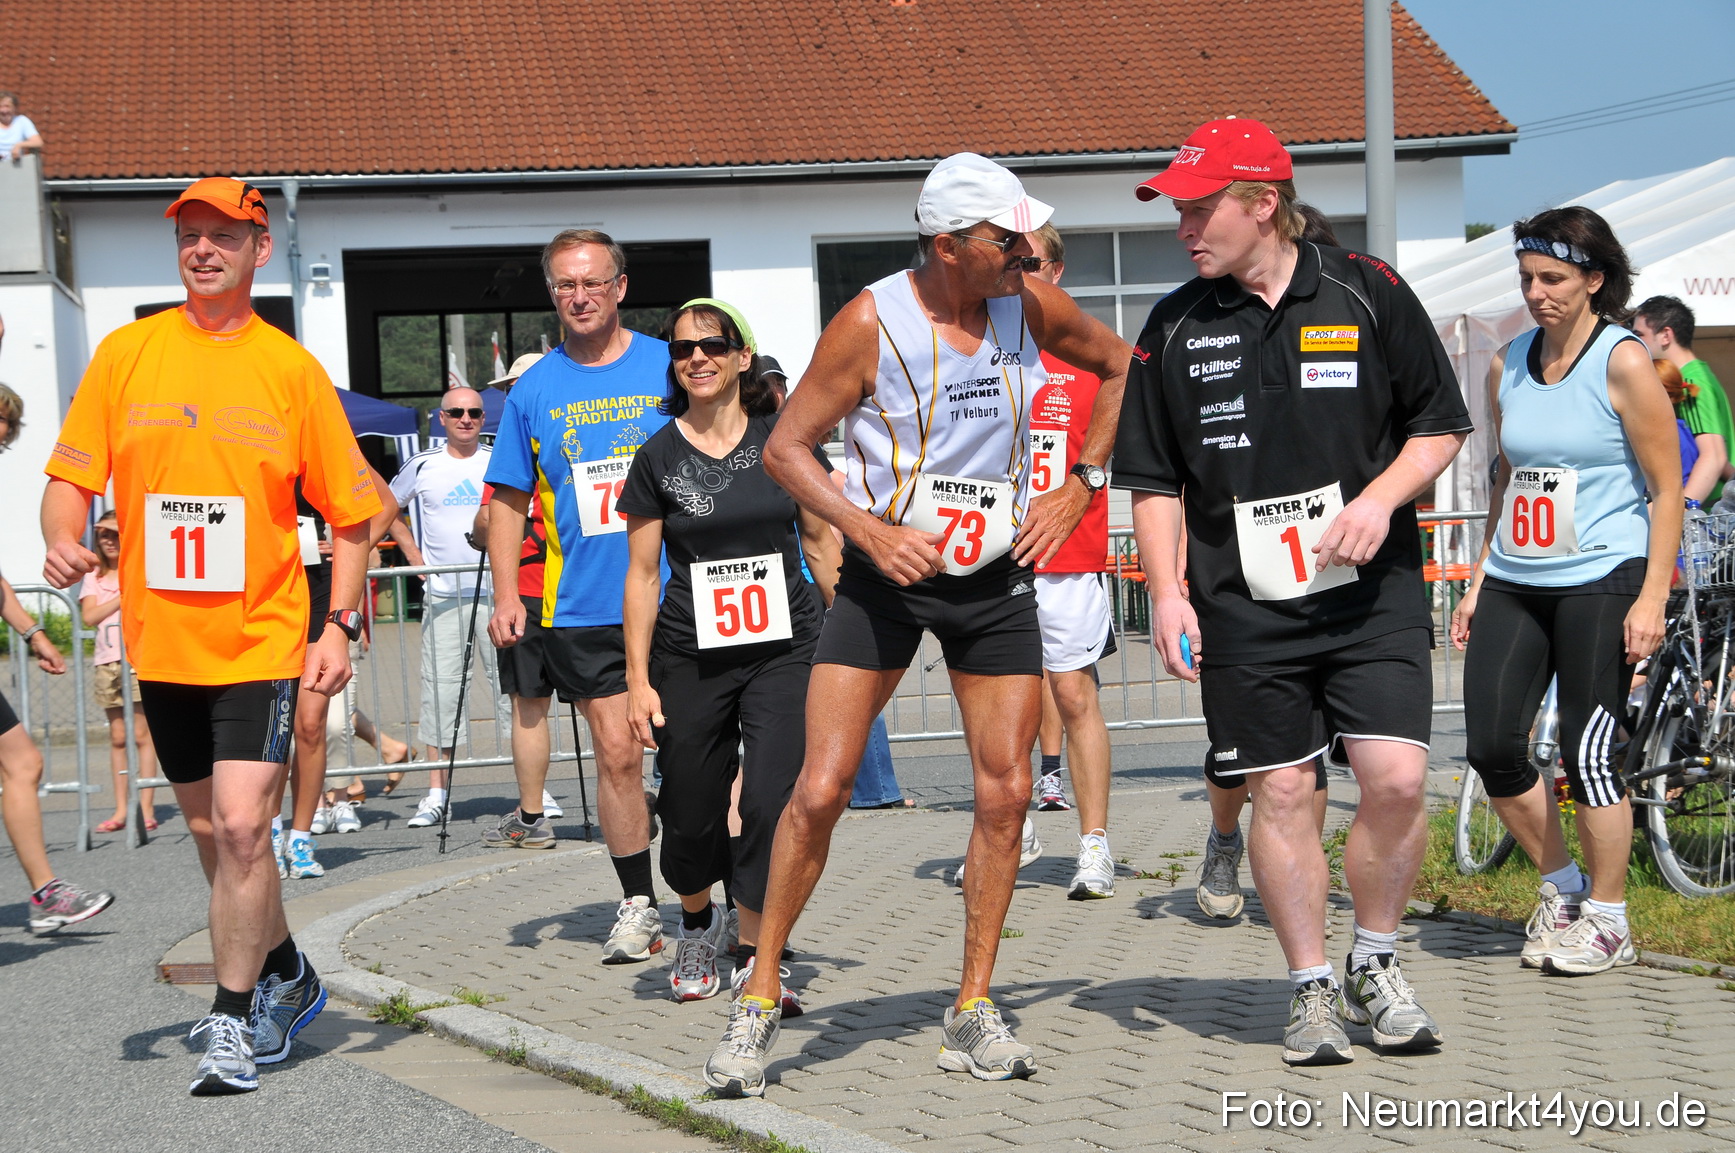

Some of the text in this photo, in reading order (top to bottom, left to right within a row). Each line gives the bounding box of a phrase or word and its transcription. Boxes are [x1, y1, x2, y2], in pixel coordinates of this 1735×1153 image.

[1233, 163, 1271, 174] www.tuja.de
[1186, 334, 1241, 350] Cellagon
[1002, 352, 1021, 366] asics
[1201, 358, 1242, 376] killtec
[1202, 372, 1234, 383] sportswear
[1319, 369, 1353, 381] victory
[953, 376, 1001, 392] INTERSPORT
[949, 388, 1001, 403] HACKNER
[550, 395, 663, 421] 10. NEUMARKTER
[950, 406, 999, 422] TV Velburg
[1200, 400, 1245, 416] AMADEUS
[565, 407, 645, 428] STADTLAUF
[1202, 434, 1237, 446] dimension
[1219, 442, 1237, 450] data
[586, 462, 624, 475] MEYER
[587, 470, 626, 482] WERBUNG
[1514, 471, 1541, 482] MEYER
[932, 480, 978, 497] MEYER
[932, 491, 978, 506] WERBUNG
[161, 501, 204, 514] MEYER
[1252, 499, 1303, 519] MEYER
[161, 512, 205, 523] WERBUNG
[1253, 511, 1305, 528] WERBUNG
[1512, 495, 1556, 548] 60
[934, 507, 987, 567] 73
[170, 526, 205, 579] 11
[1280, 526, 1308, 583] 1
[706, 562, 749, 577] MEYER
[707, 572, 751, 584] WERBUNG
[713, 584, 769, 637] 50
